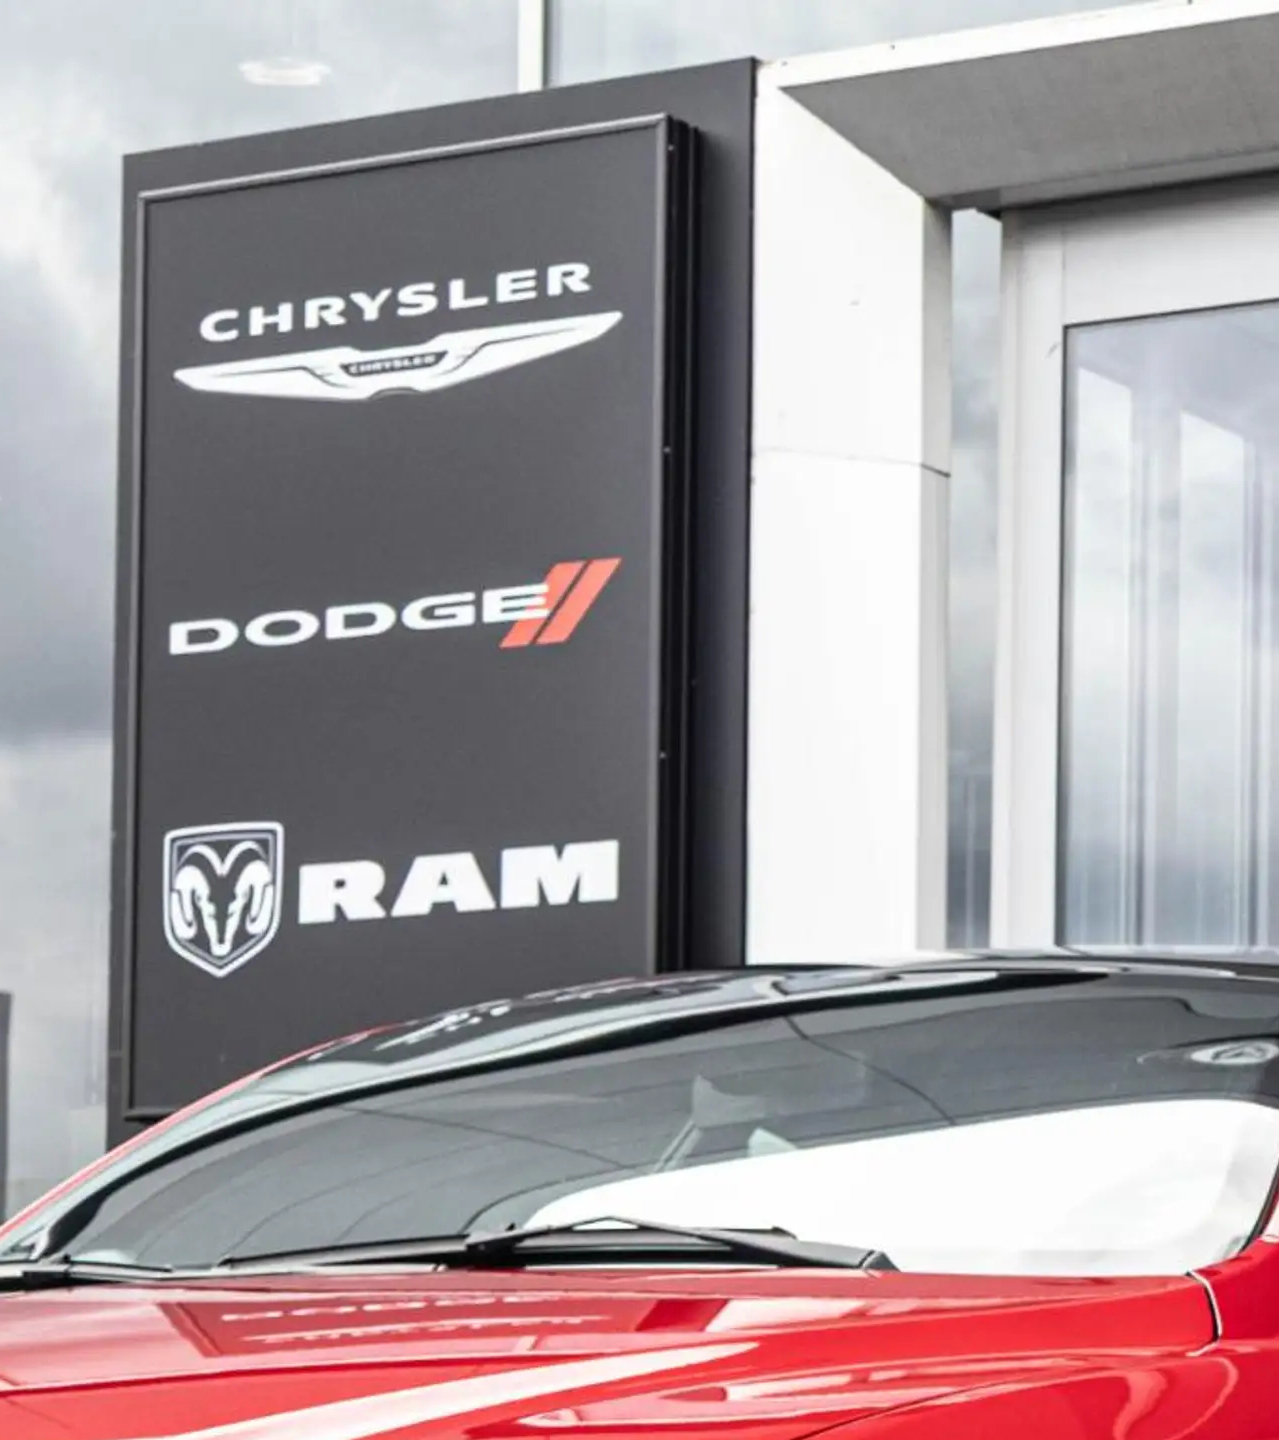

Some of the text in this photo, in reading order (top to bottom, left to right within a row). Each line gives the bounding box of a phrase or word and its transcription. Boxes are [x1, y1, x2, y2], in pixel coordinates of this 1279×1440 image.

[200, 262, 591, 342] CHRYSLER
[348, 354, 436, 375] CHRYSLER
[169, 582, 548, 655] DODGE
[297, 839, 619, 924] RAM
